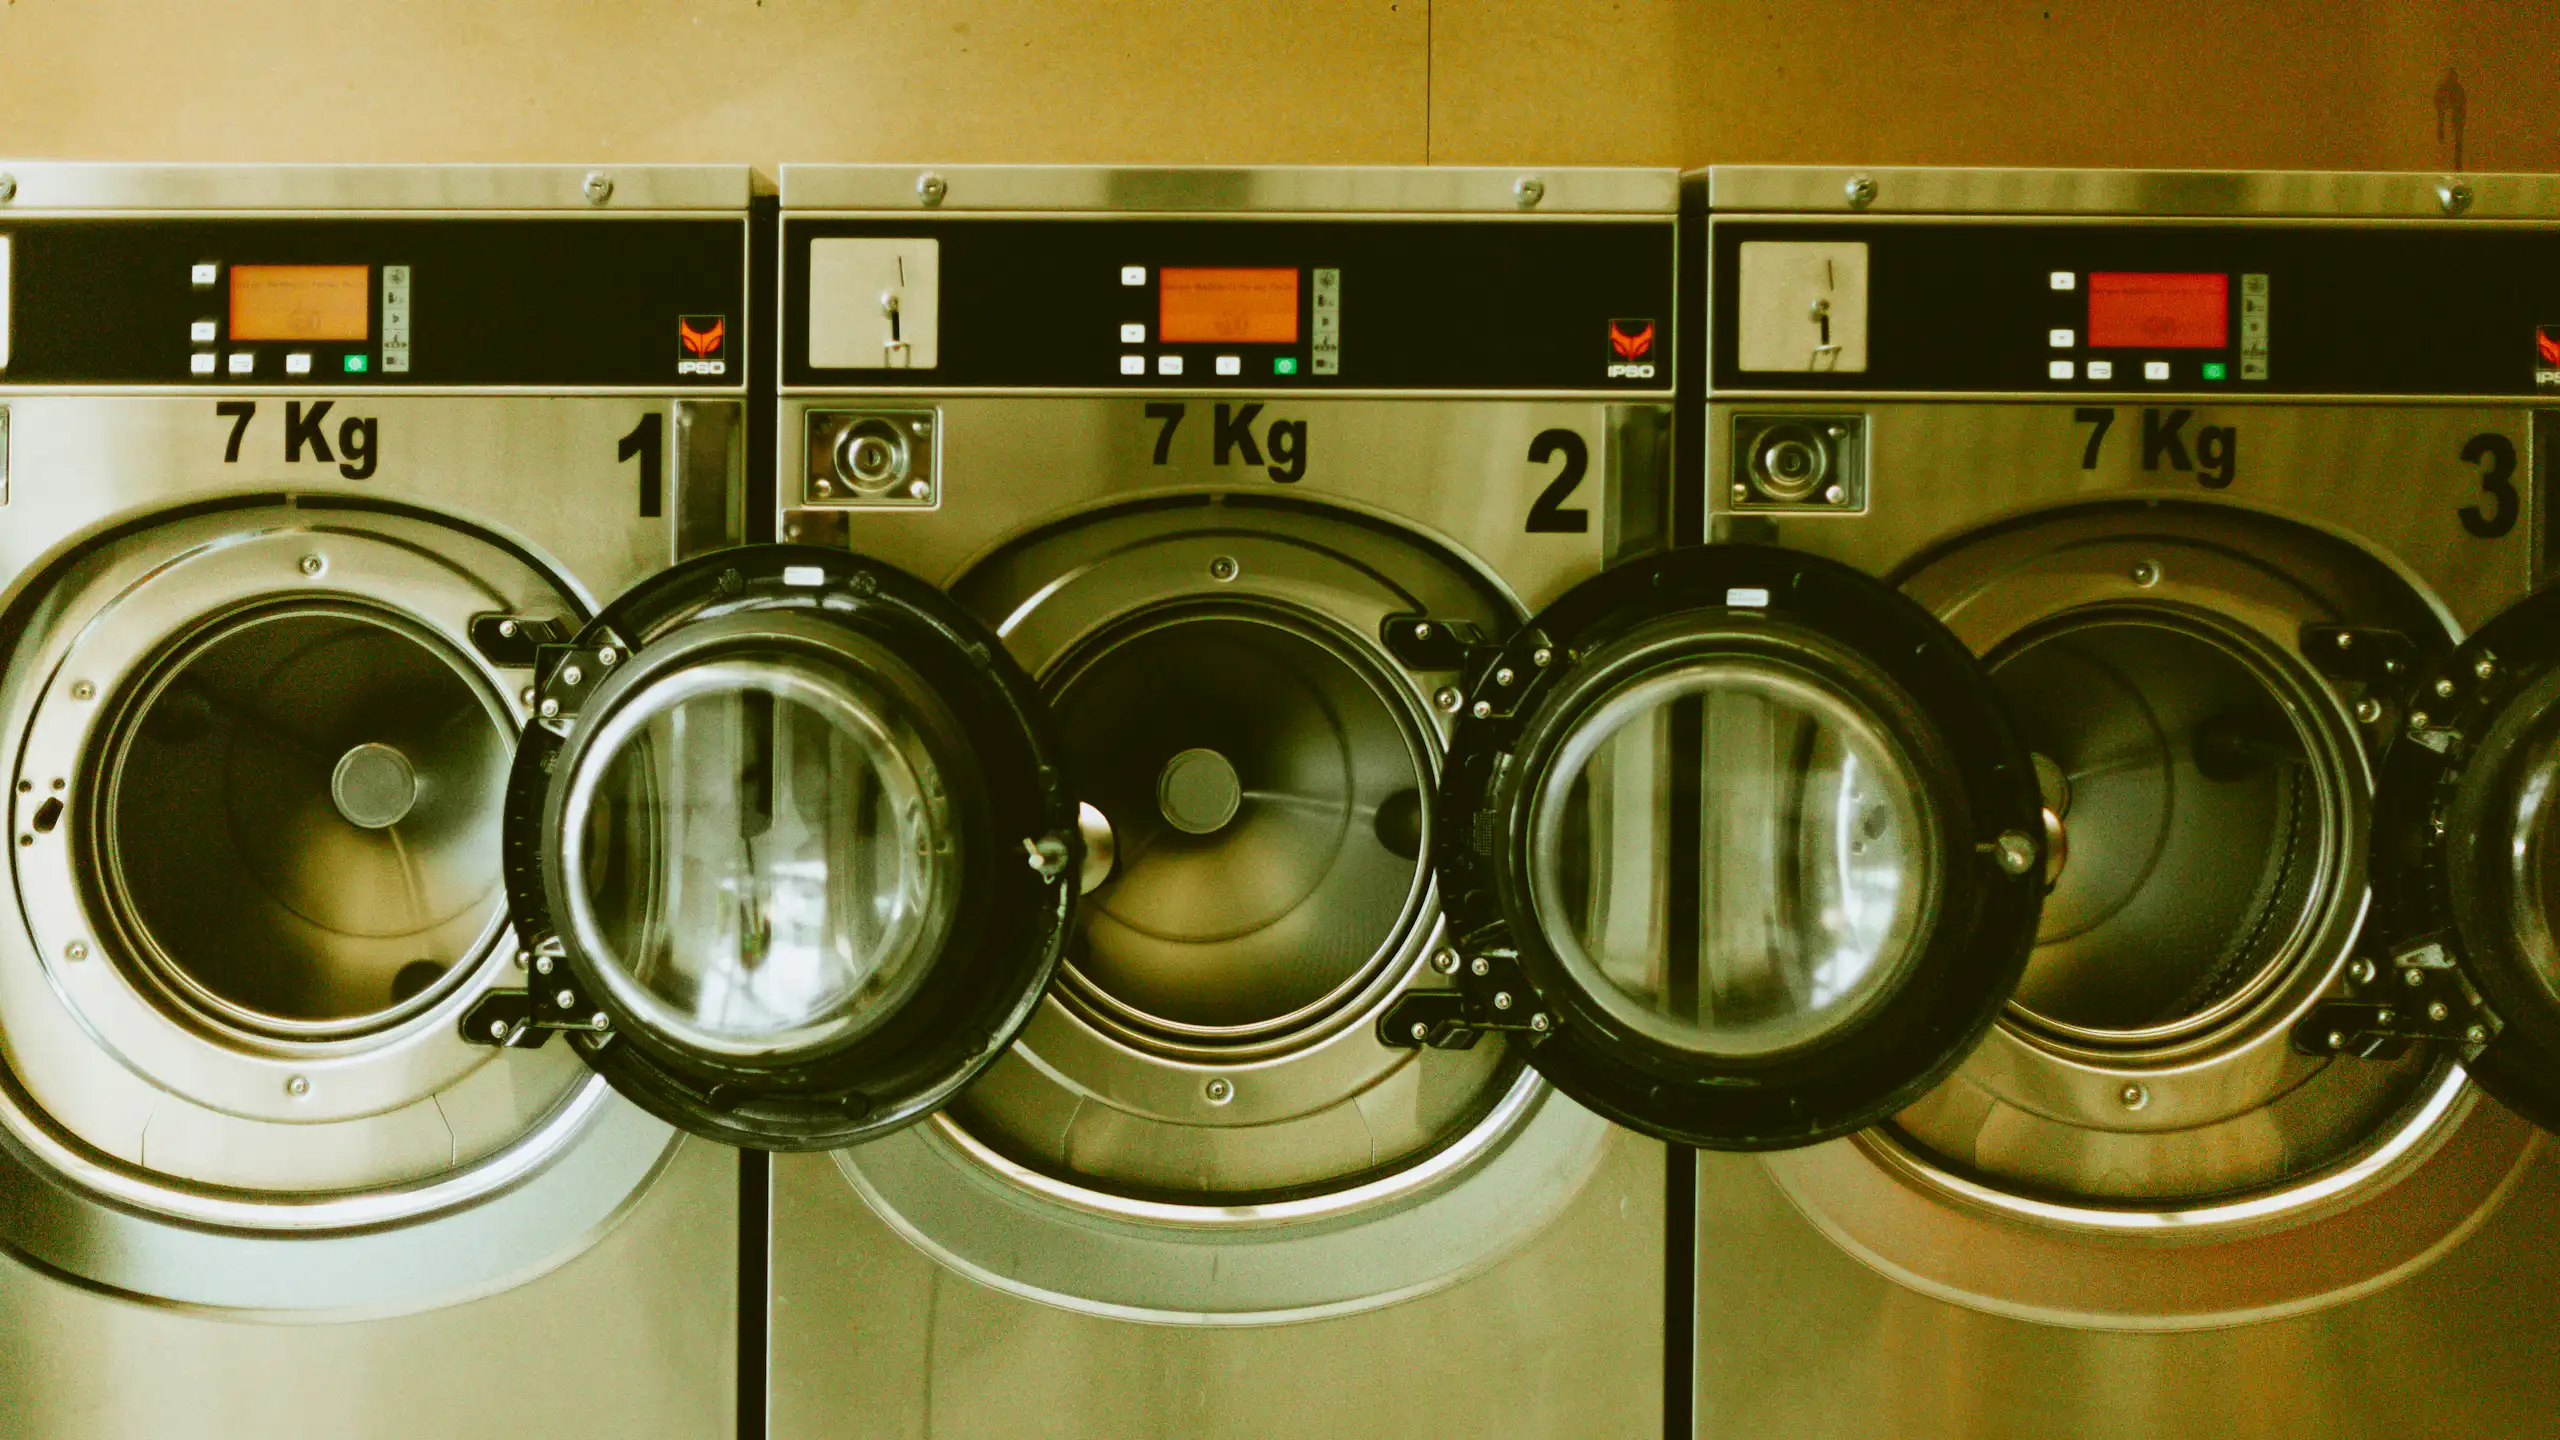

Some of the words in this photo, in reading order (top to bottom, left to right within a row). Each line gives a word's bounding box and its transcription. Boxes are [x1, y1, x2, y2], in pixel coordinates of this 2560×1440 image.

[678, 361, 726, 375] IPSO
[1607, 365, 1655, 379] IPSO
[216, 401, 256, 463] 7
[285, 401, 378, 480] Kg
[617, 413, 662, 518] 1
[1144, 402, 1185, 466] 7
[1212, 402, 1307, 484] Kg
[1524, 428, 1589, 534] 2
[2074, 407, 2115, 470] 7
[2142, 408, 2237, 489] Kg
[2457, 432, 2520, 540] 3
